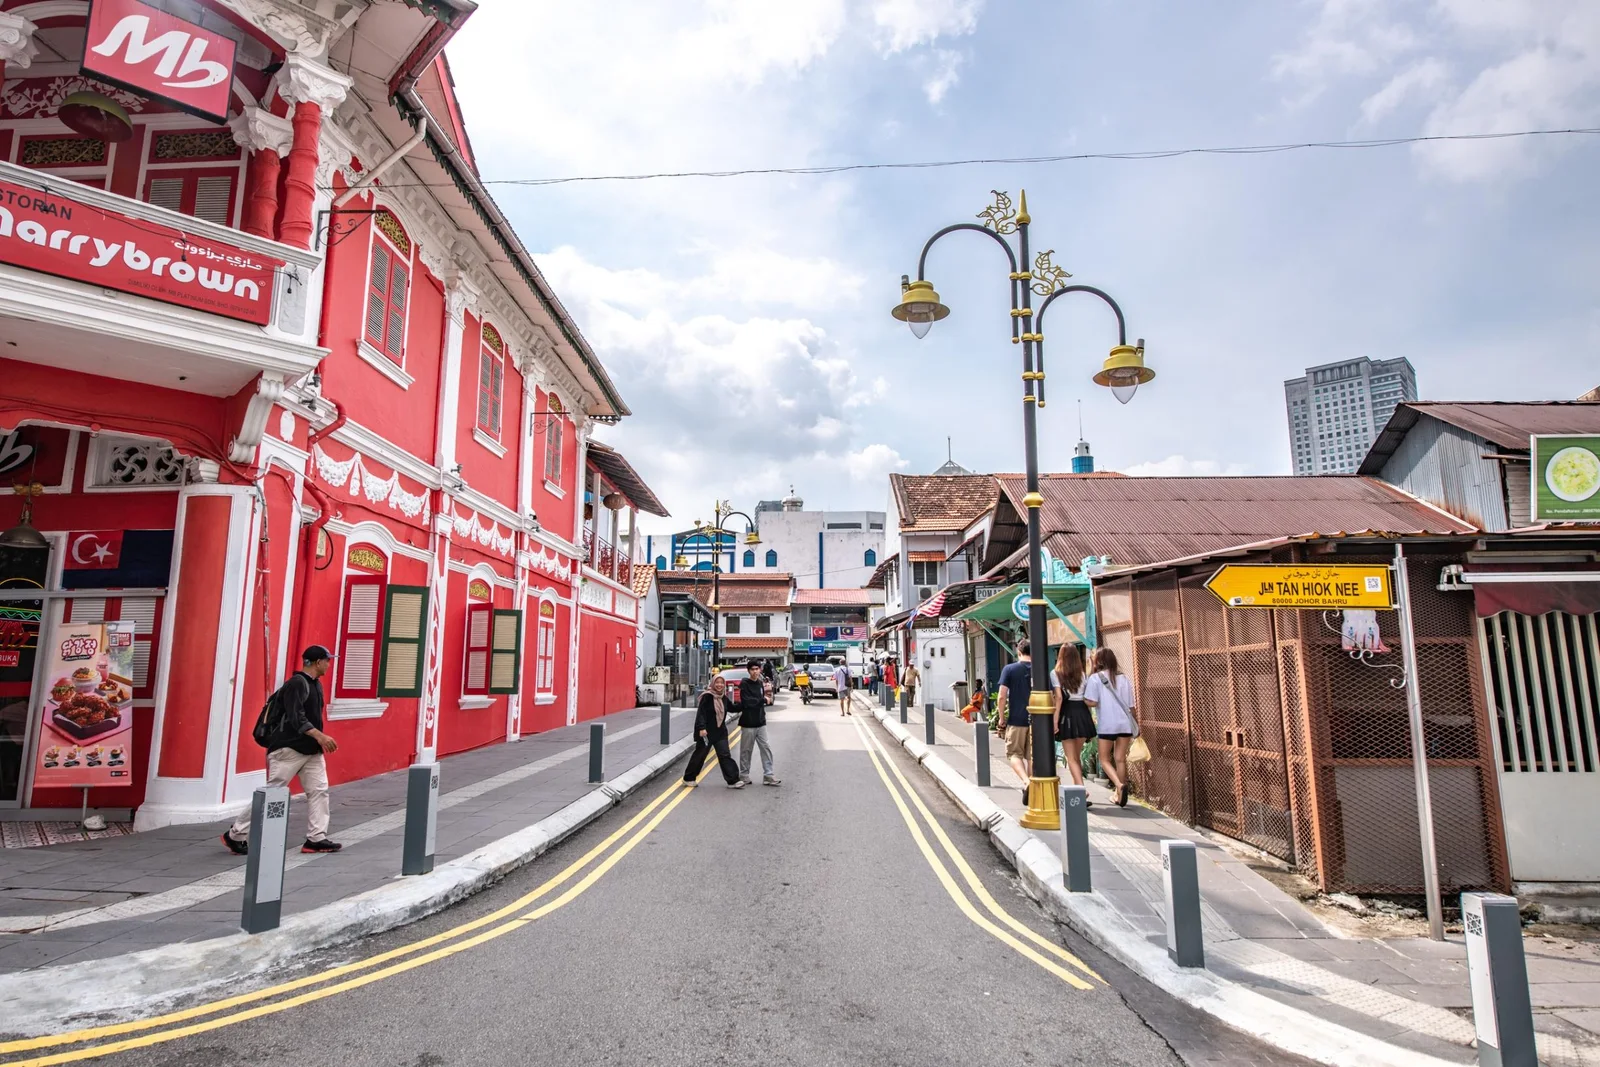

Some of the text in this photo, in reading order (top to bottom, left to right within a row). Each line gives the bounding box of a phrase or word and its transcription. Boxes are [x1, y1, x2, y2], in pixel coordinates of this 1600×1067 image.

[91, 14, 228, 88] Mb
[177, 290, 205, 303] PLATINUM
[1276, 582, 1299, 596] TAN
[1302, 582, 1332, 596] HIOK
[1335, 583, 1360, 597] NEE
